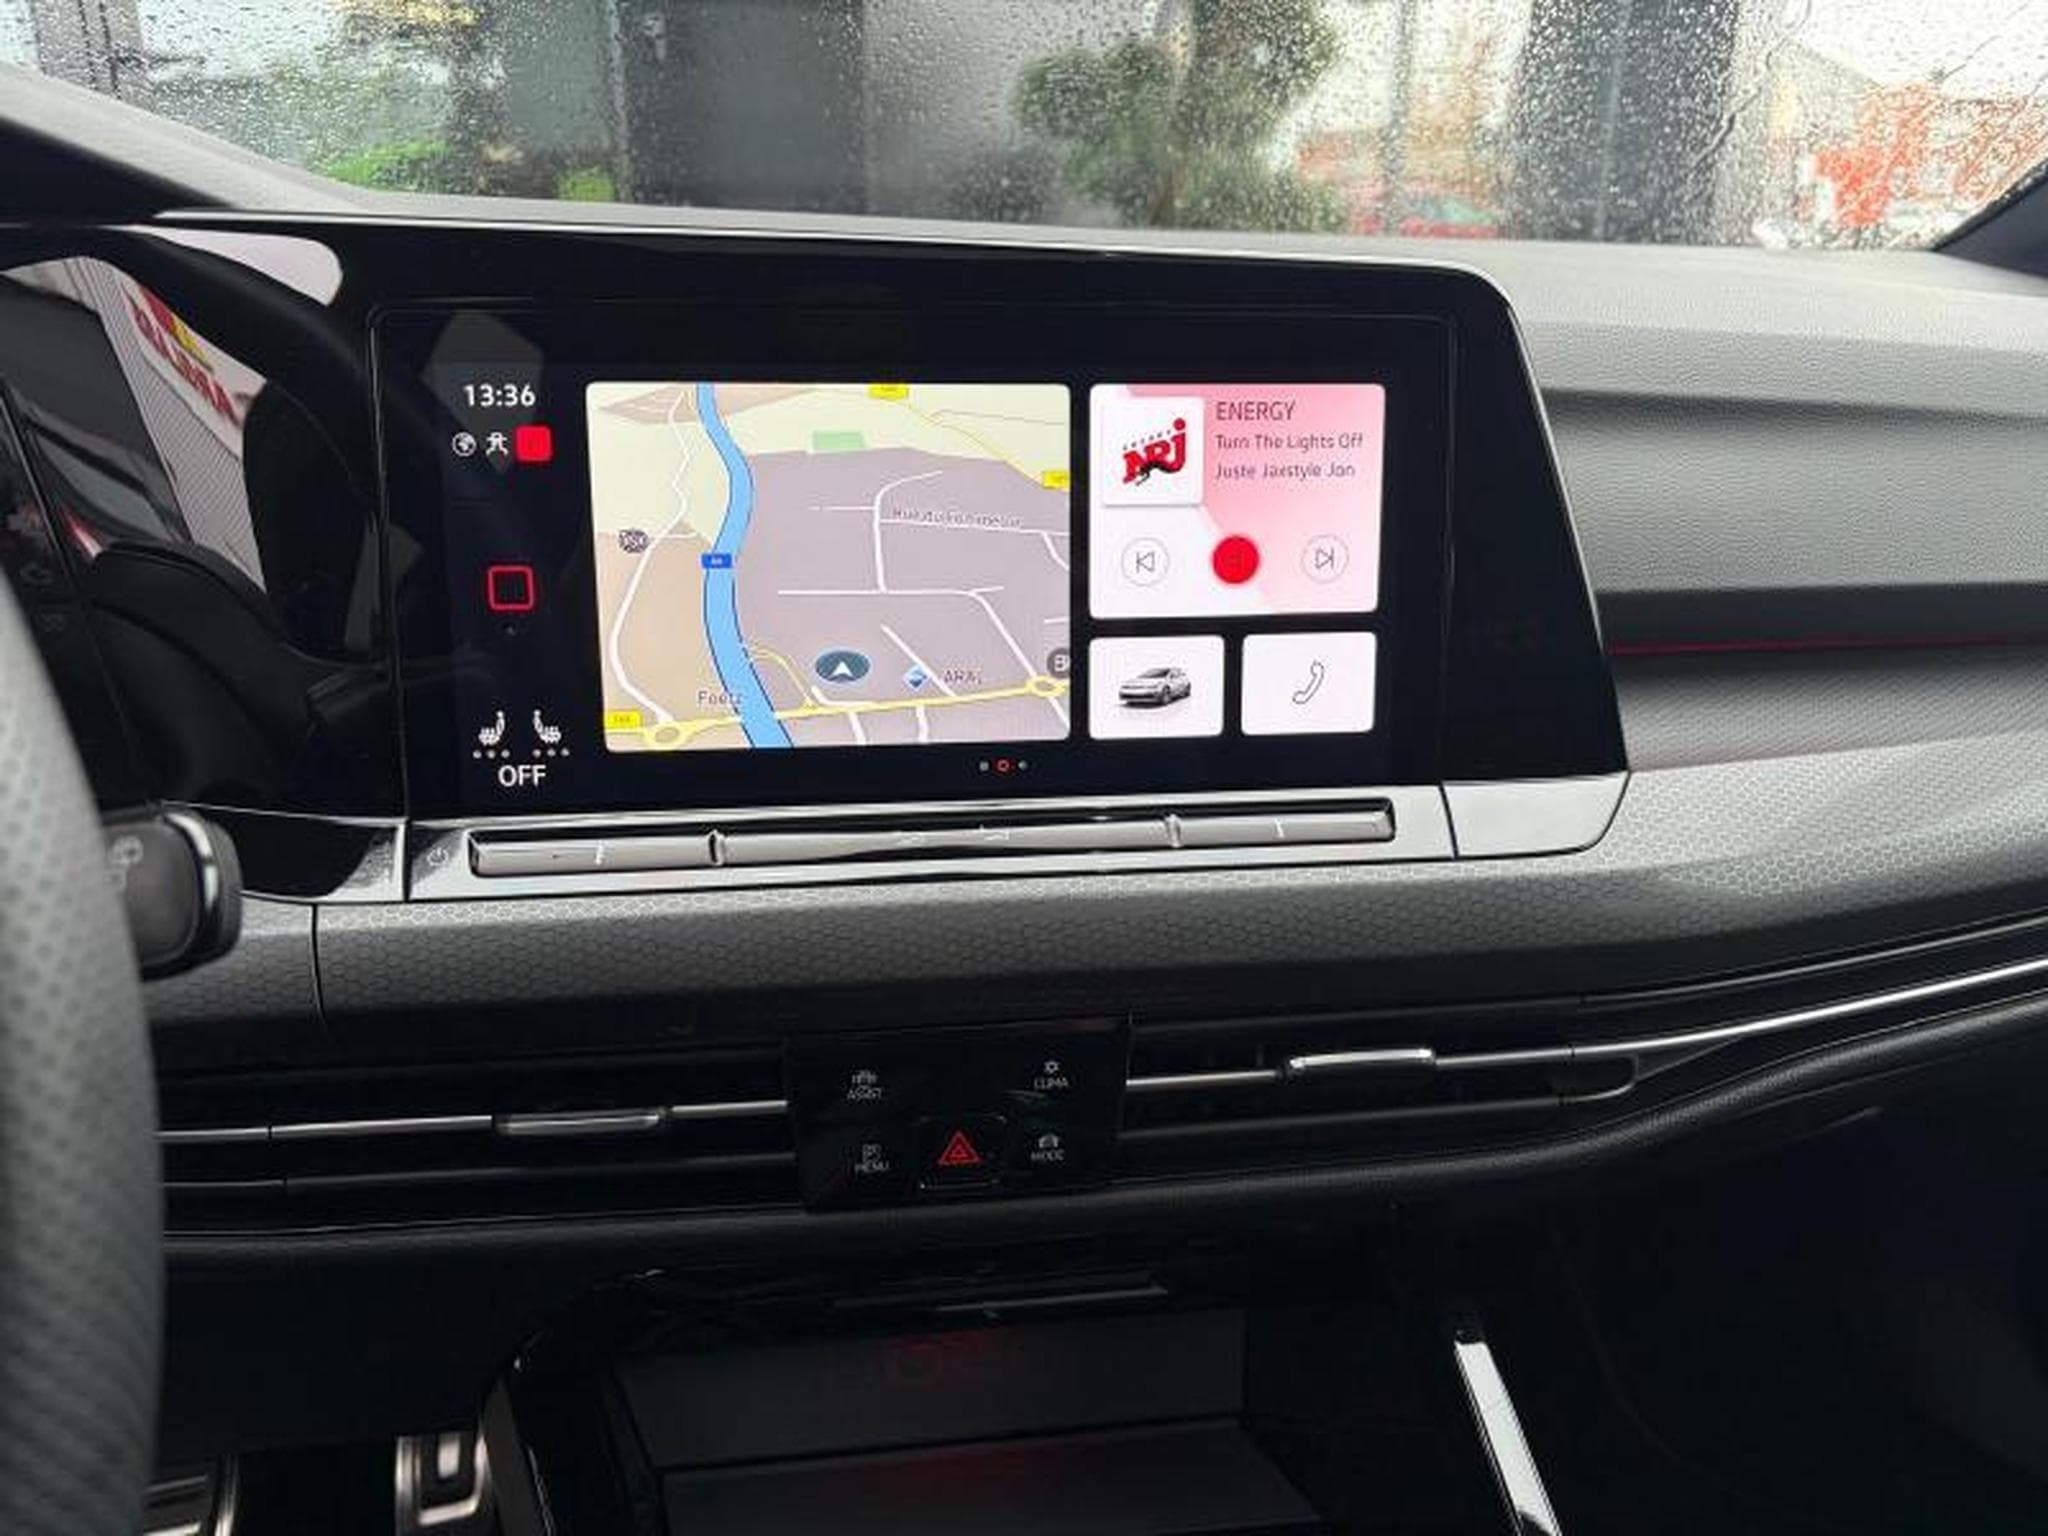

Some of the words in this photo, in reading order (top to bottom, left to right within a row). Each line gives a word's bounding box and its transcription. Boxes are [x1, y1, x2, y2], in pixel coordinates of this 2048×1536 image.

[462, 384, 536, 407] 13:36
[1216, 401, 1295, 421] ENERGY
[1215, 433, 1250, 449] Turn
[1255, 433, 1283, 450] The
[1286, 432, 1334, 453] Lights
[1338, 431, 1362, 449] Off
[498, 764, 547, 787] OFF
